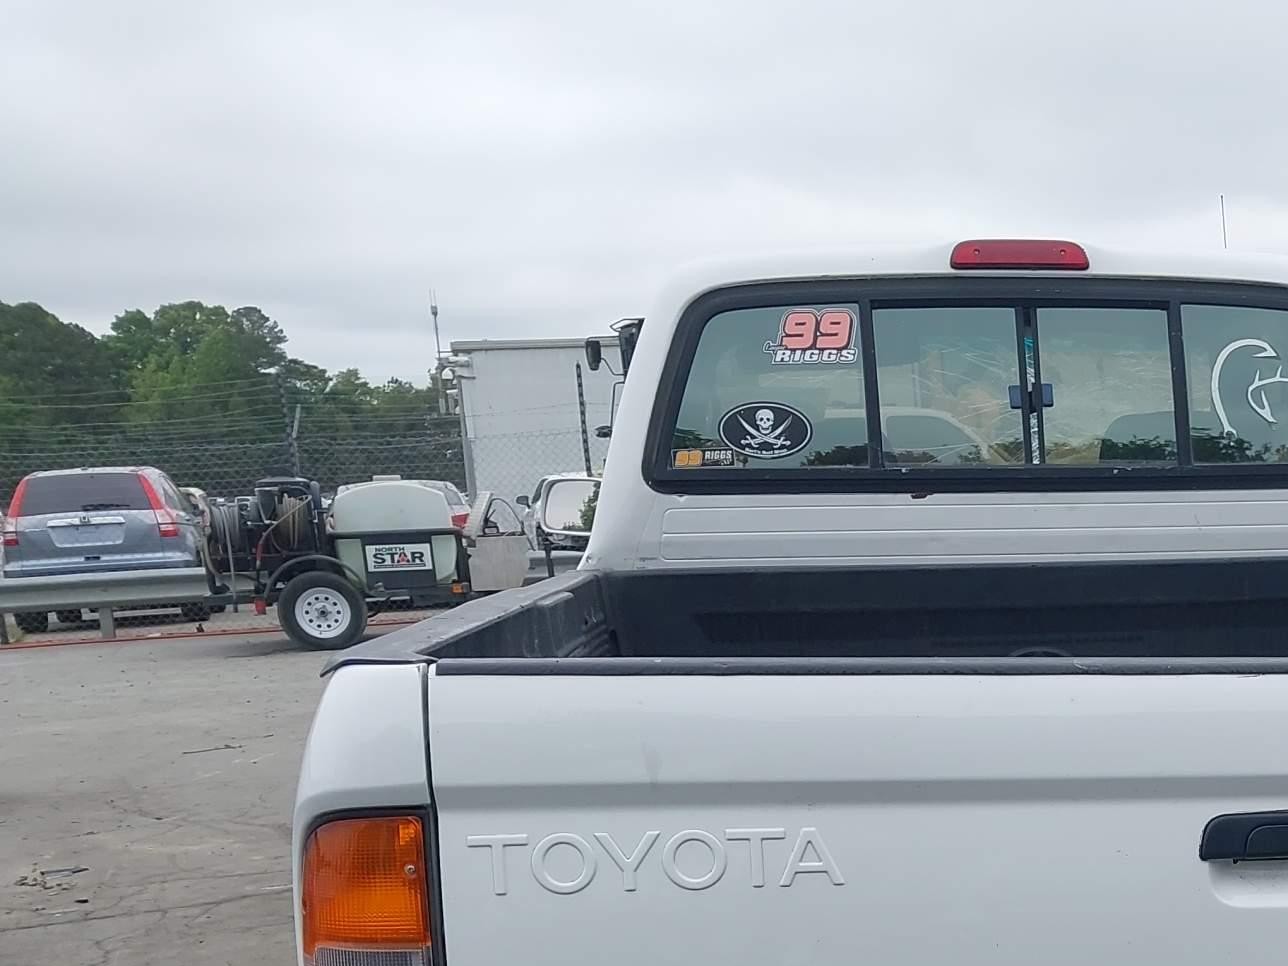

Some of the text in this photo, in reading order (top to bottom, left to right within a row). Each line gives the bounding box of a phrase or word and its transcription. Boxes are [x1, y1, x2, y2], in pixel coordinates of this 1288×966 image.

[781, 311, 853, 349] 99
[774, 349, 856, 362] RIGGS
[704, 450, 733, 461] RIGGS
[372, 551, 425, 565] STAR
[466, 827, 846, 896] TOYOTA
